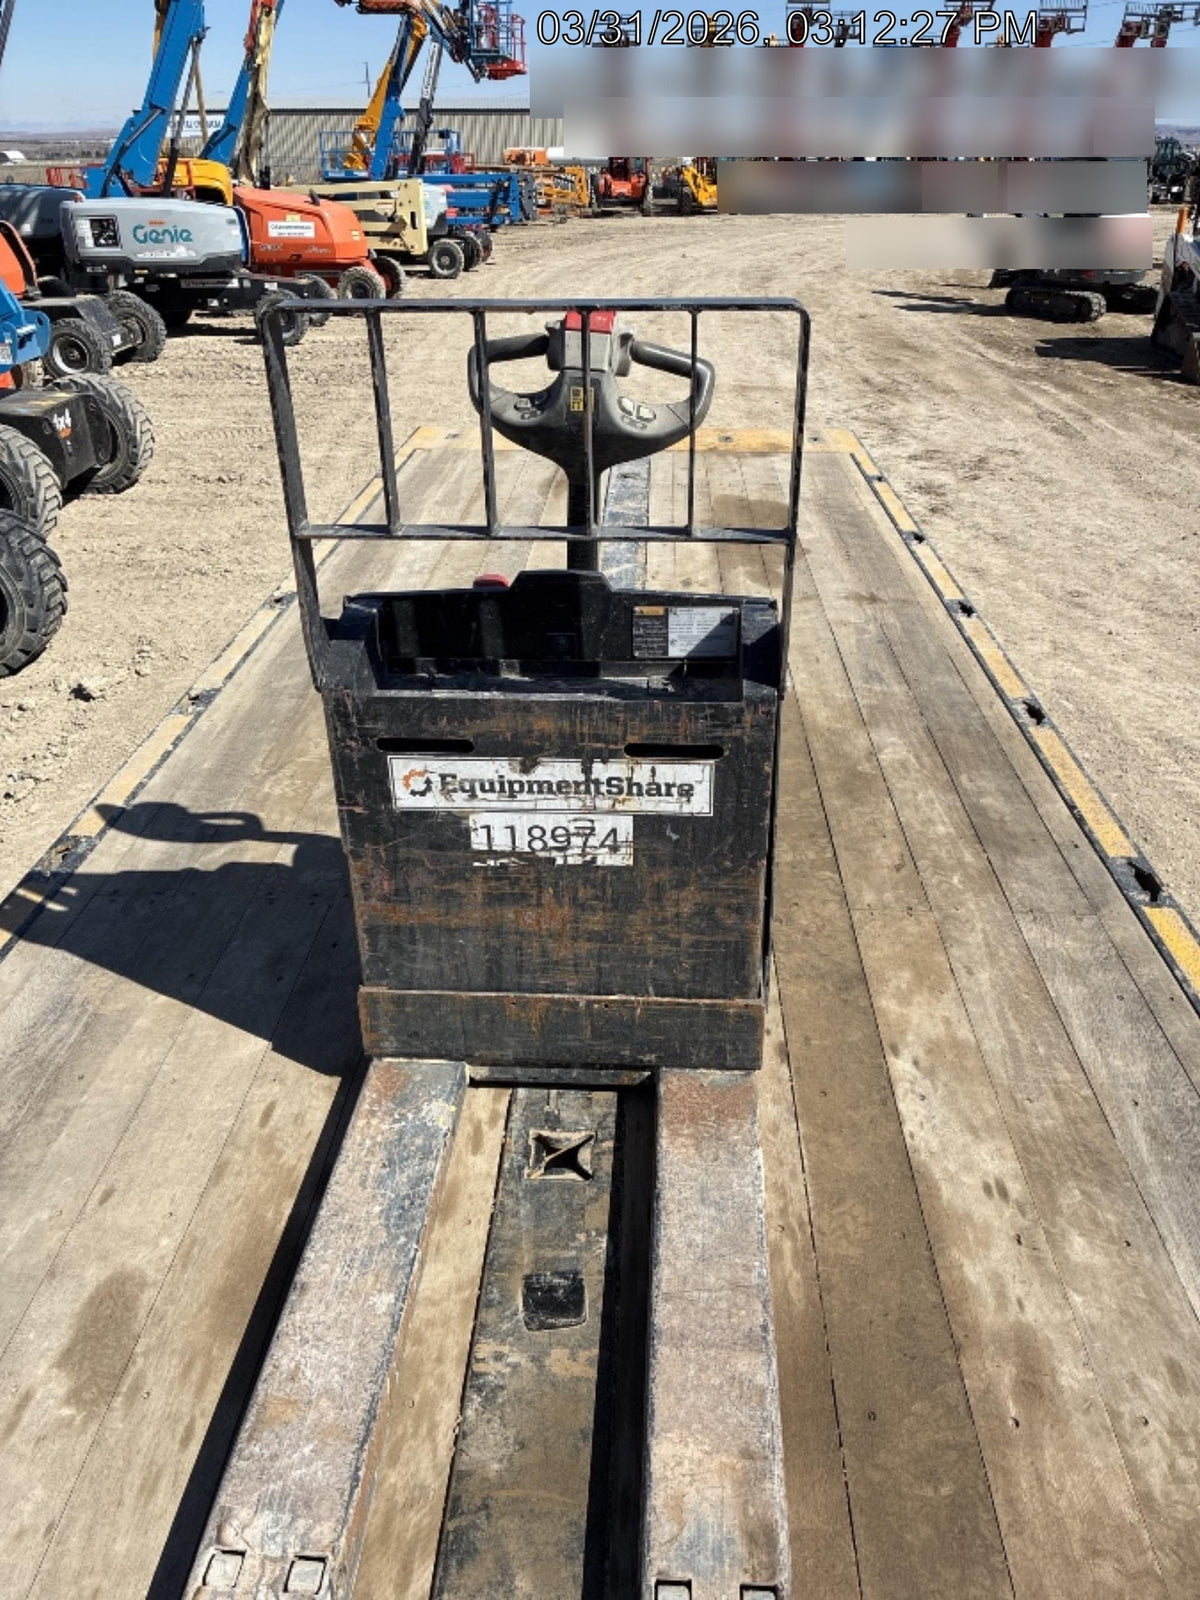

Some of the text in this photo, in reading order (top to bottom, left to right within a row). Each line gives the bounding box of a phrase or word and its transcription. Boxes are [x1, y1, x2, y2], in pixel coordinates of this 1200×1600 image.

[133, 224, 193, 244] Genie
[437, 772, 696, 799] EquipmentShare
[479, 825, 621, 853] 118974
